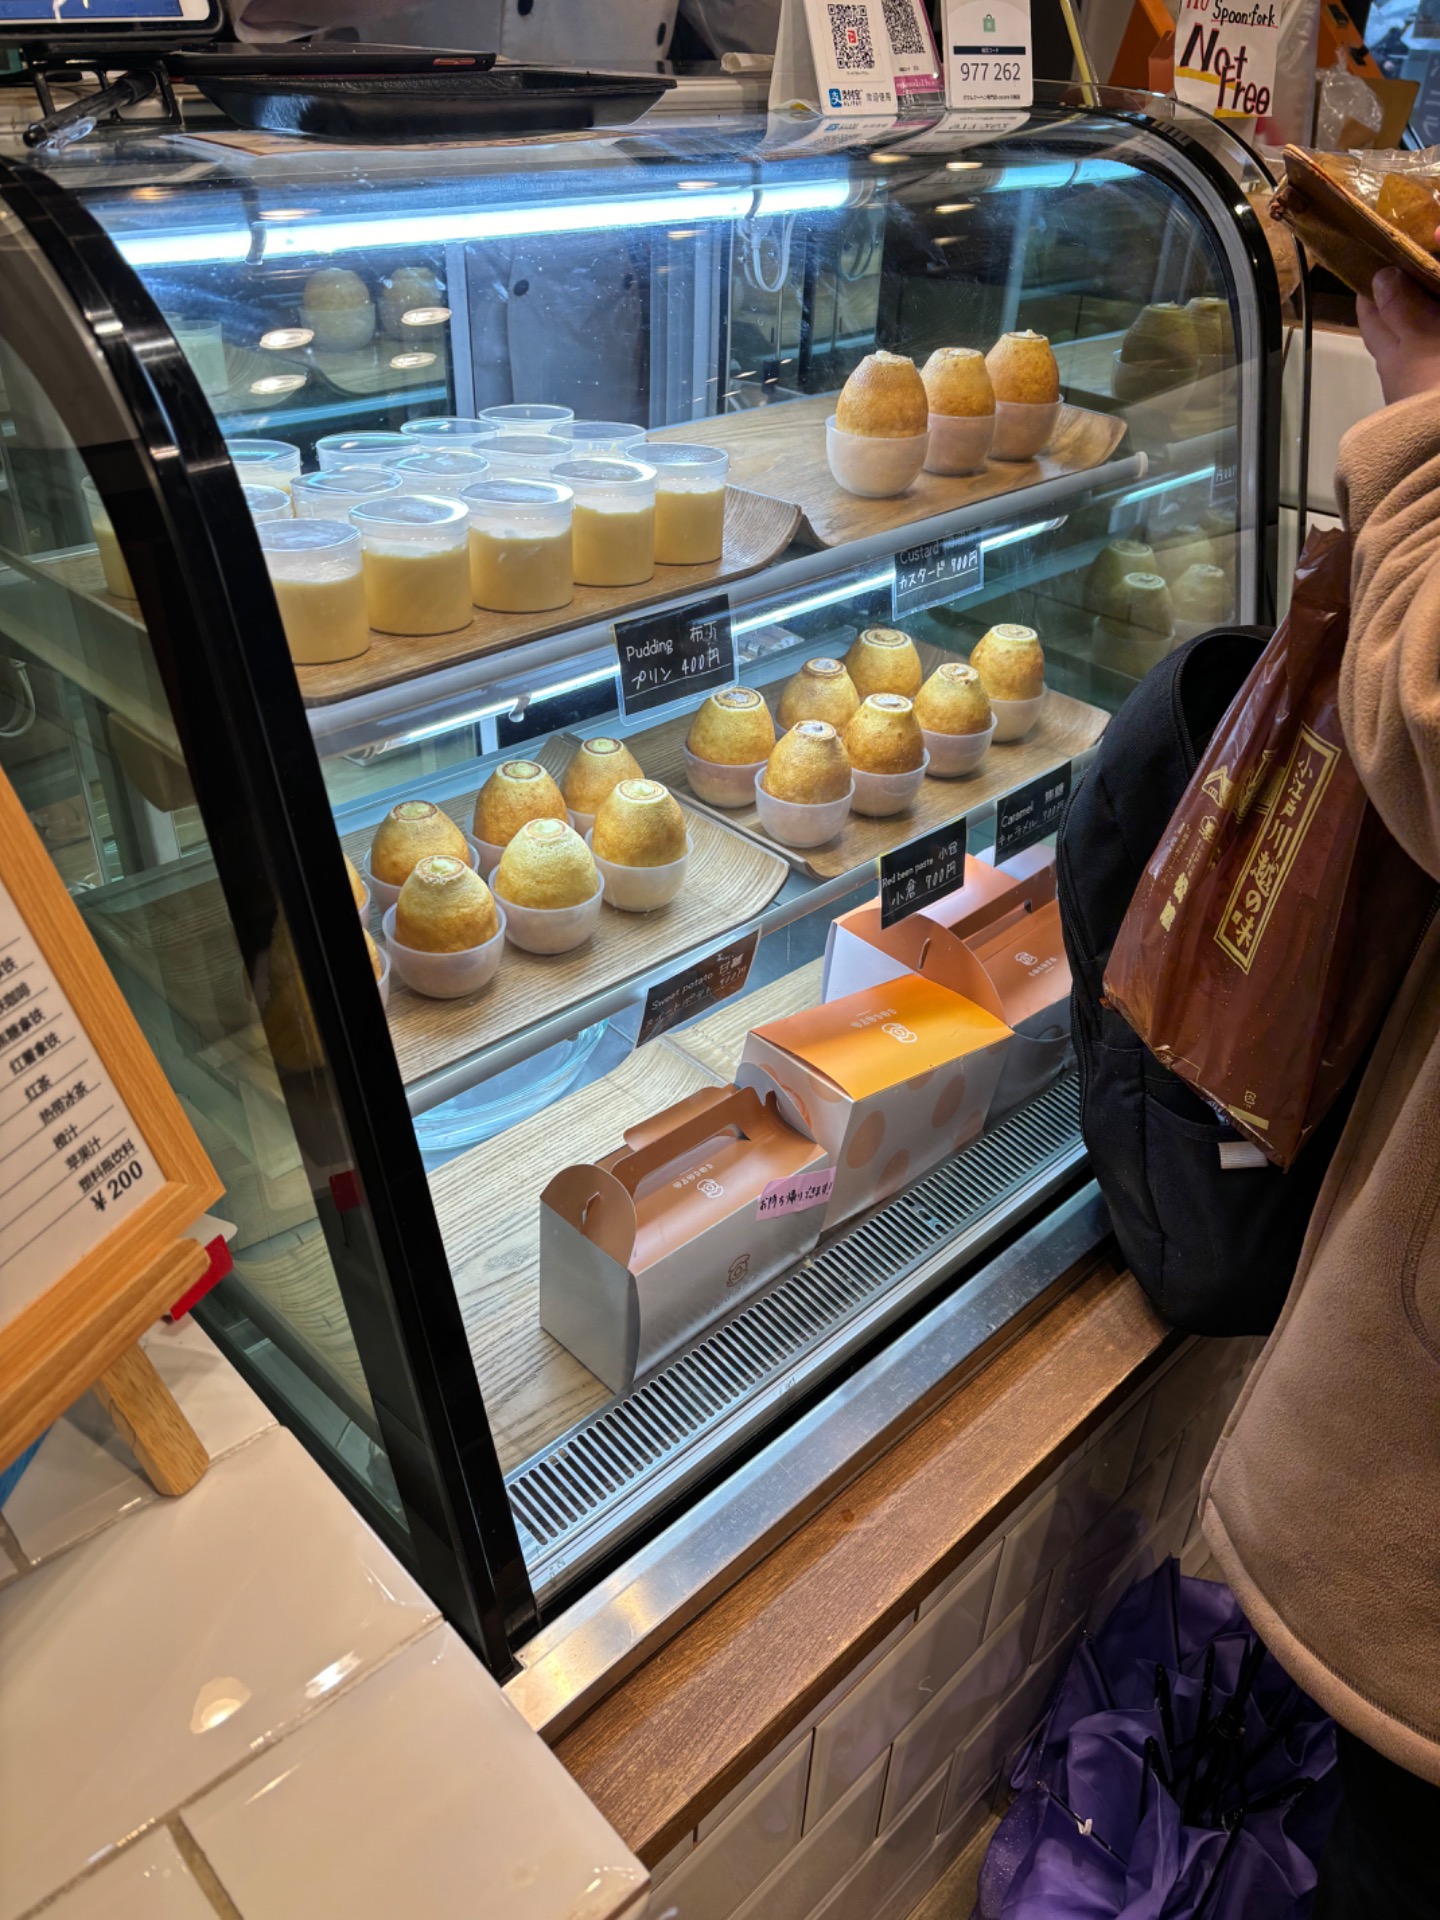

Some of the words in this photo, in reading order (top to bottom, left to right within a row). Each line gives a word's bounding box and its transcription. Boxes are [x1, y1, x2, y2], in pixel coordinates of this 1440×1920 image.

[1179, 22, 1249, 80] Not
[960, 62, 989, 82] 977
[994, 62, 1021, 81] 262
[1217, 65, 1270, 115] Free
[900, 539, 939, 565] Custard
[898, 560, 946, 589] カスタード
[625, 638, 674, 662] Pudding
[631, 667, 672, 690] プリン
[681, 647, 720, 675] 400円
[24, 1075, 52, 1102] 红茶
[53, 1124, 78, 1151] 橙汁
[65, 1136, 101, 1171] 苹果汁
[78, 1138, 135, 1193] 塑料瓶饮料
[106, 1160, 143, 1200] 200
